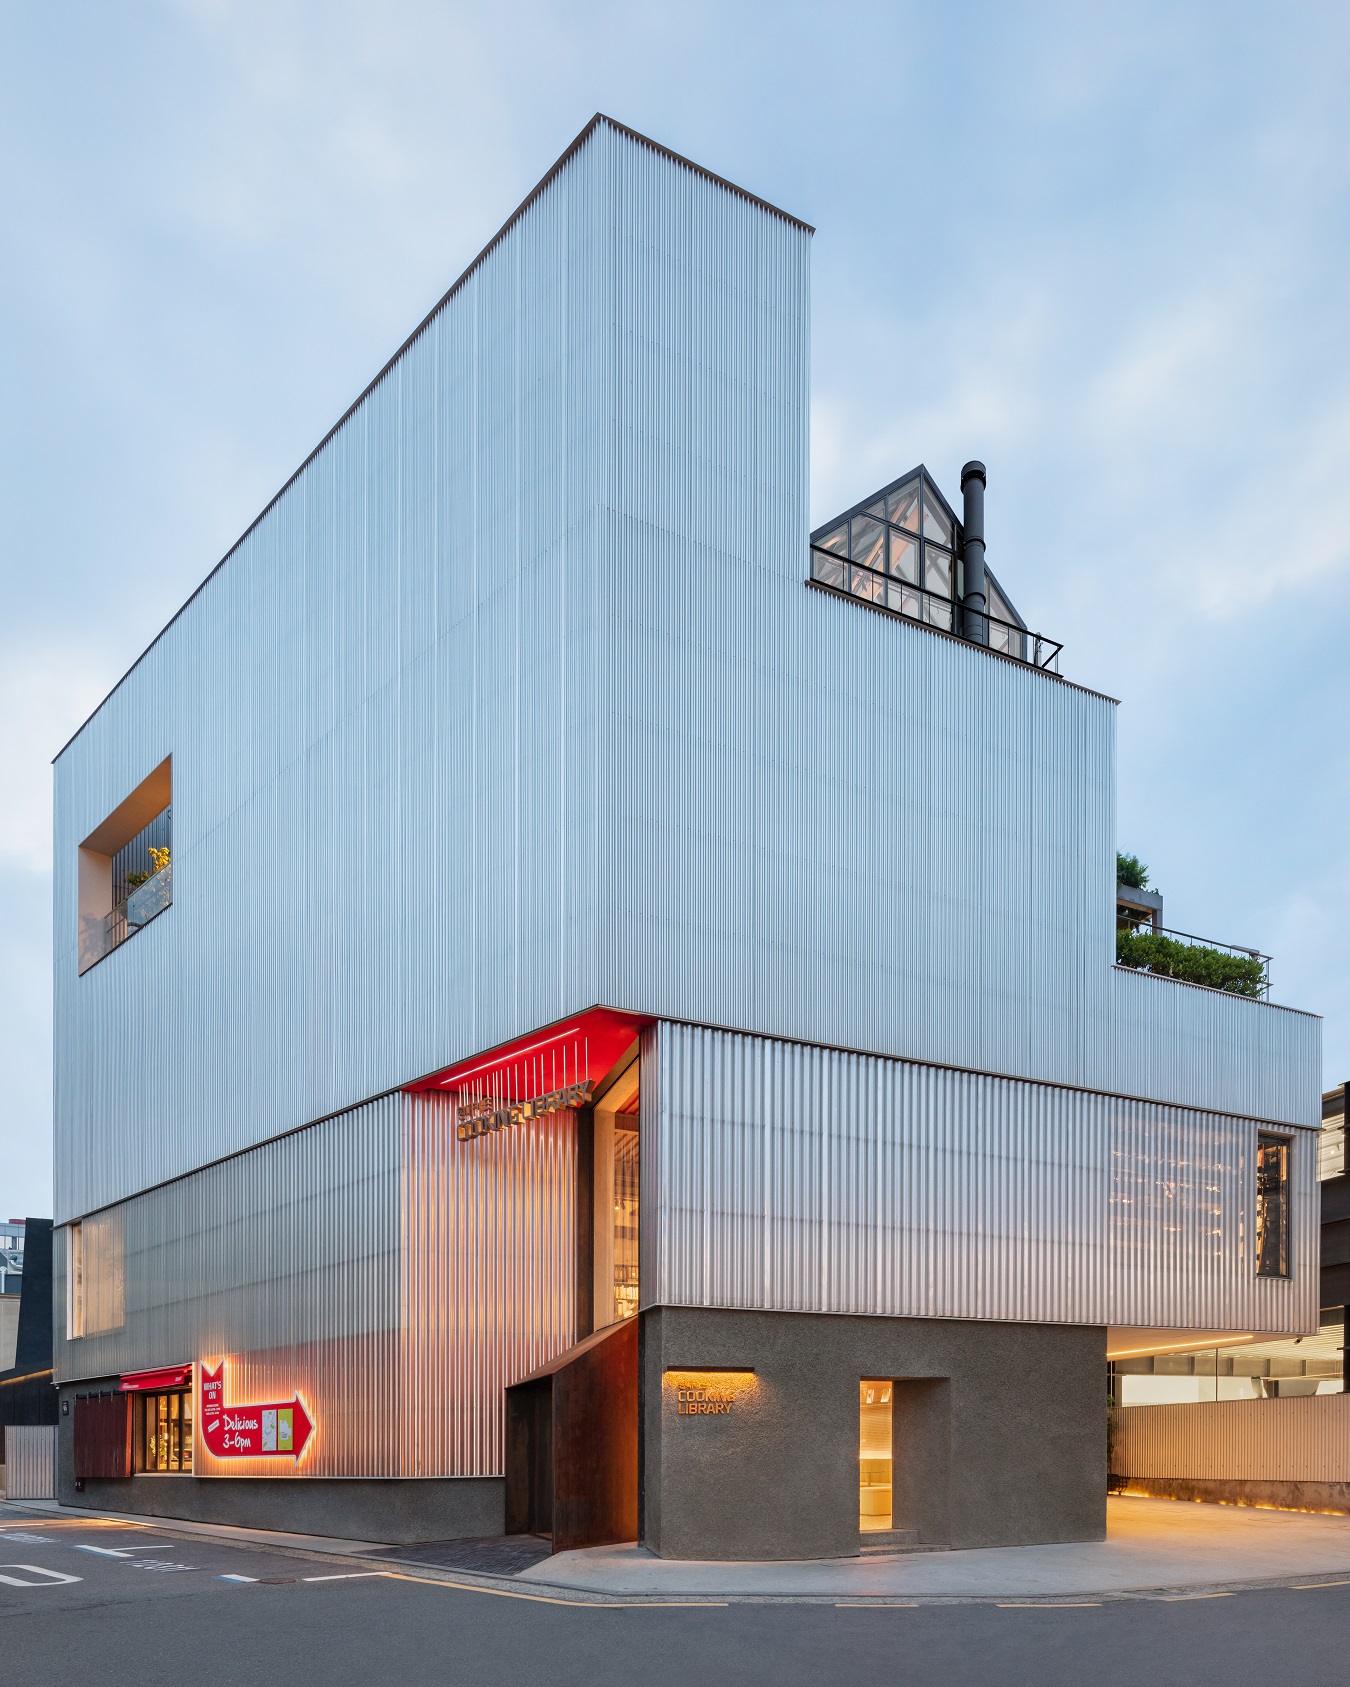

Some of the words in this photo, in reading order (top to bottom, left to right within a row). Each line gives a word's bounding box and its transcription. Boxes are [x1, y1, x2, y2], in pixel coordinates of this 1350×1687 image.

[457, 1103, 523, 1142] COOKING
[523, 1079, 595, 1120] LIBRARY
[208, 1391, 216, 1399] ON
[678, 1391, 736, 1402] COOKING
[678, 1403, 733, 1414] LIBRARY
[223, 1414, 258, 1430] Delicious
[223, 1432, 251, 1452] 3-6pm
